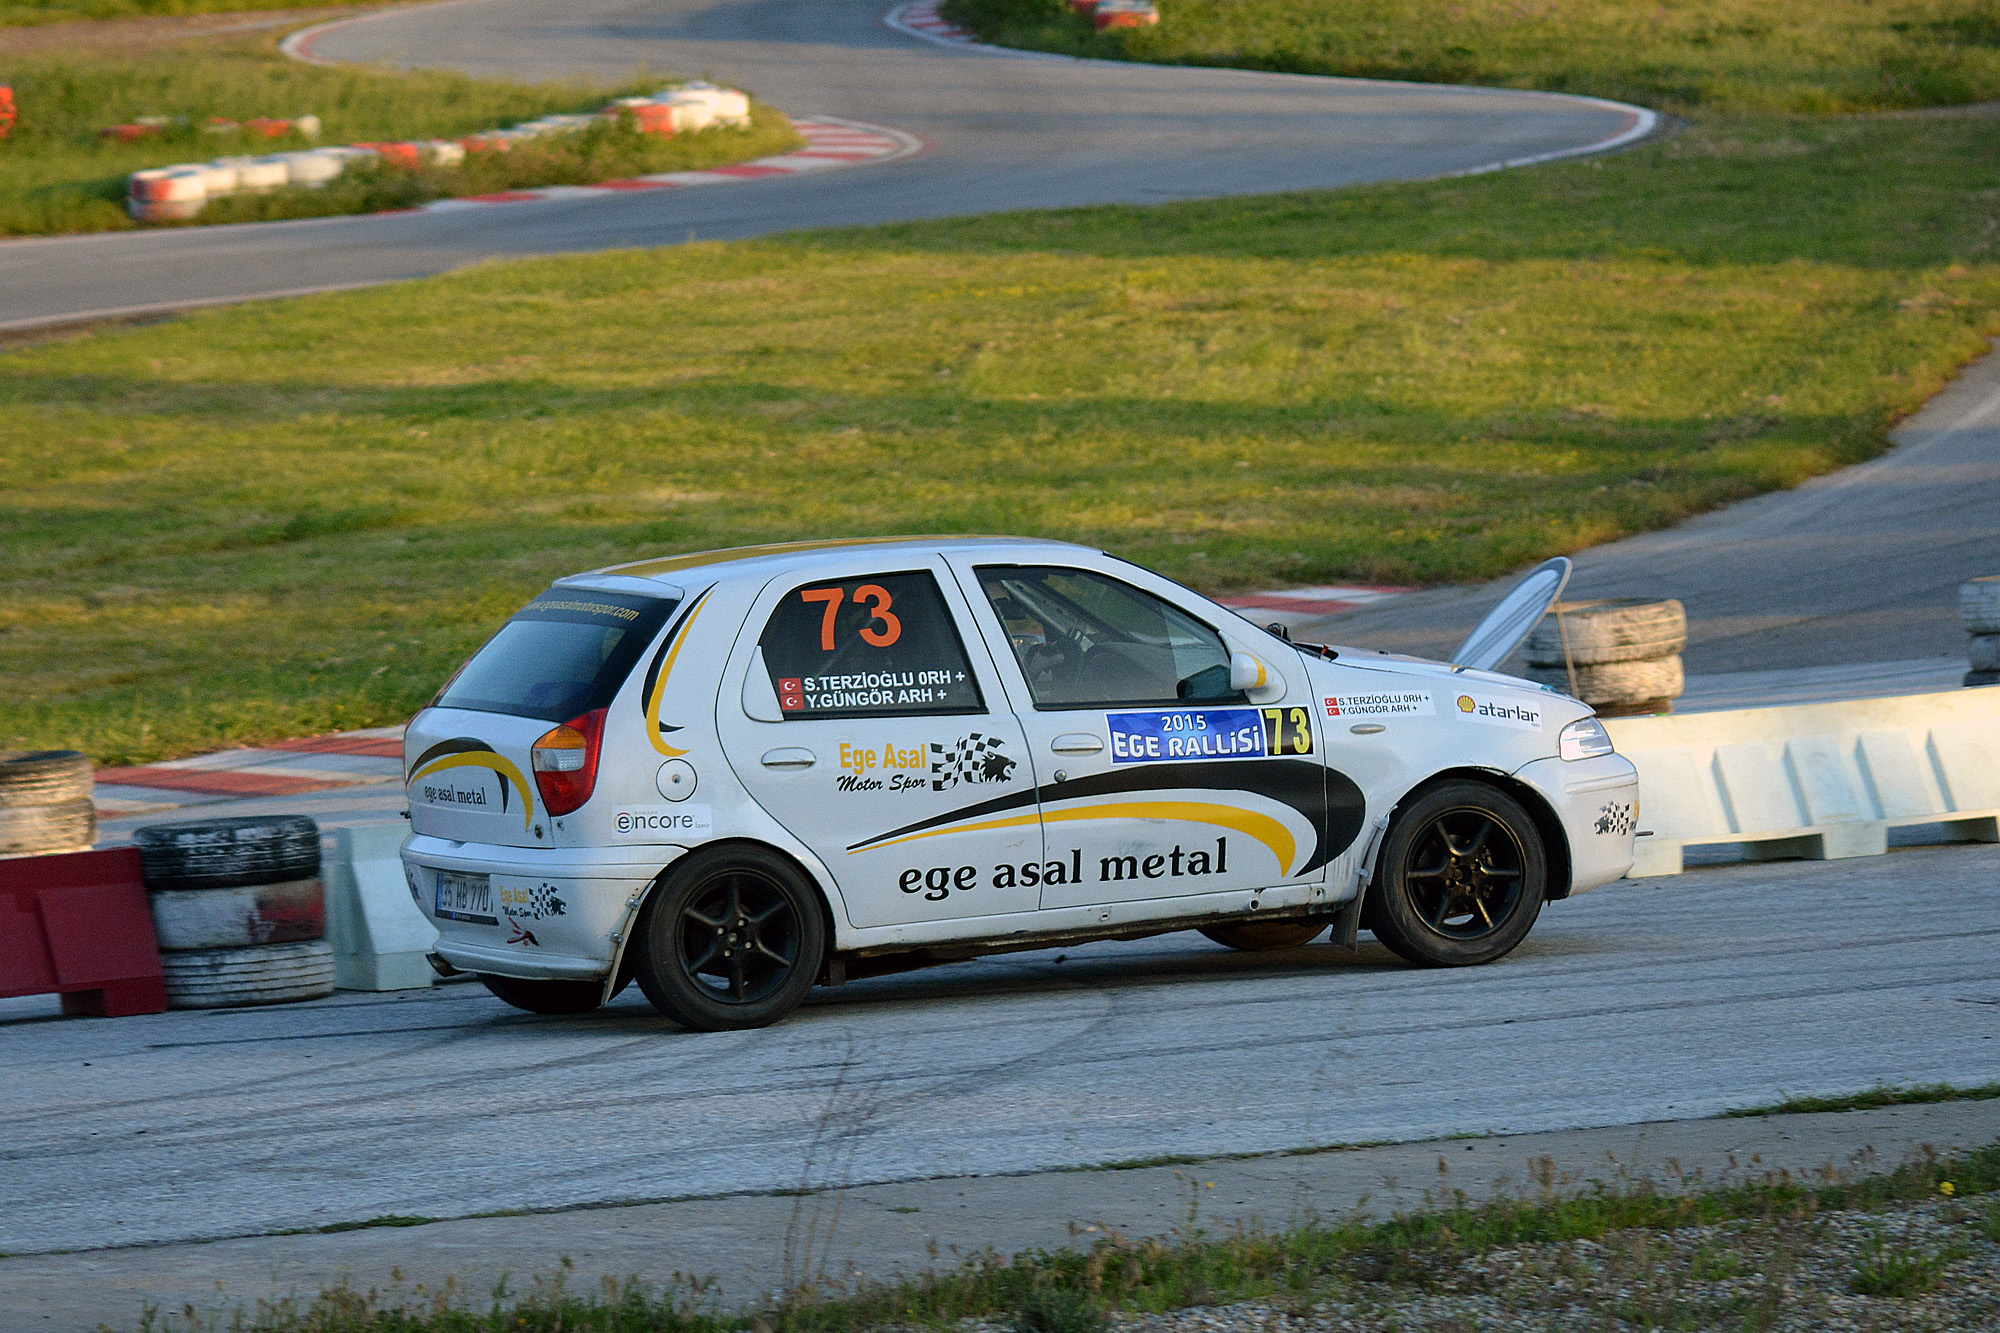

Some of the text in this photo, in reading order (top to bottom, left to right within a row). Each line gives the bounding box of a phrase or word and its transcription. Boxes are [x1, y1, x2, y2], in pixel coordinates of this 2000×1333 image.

[801, 584, 901, 650] 73
[805, 689, 894, 708] Y.GÜNGÖR
[897, 688, 933, 704] ARH
[1340, 705, 1388, 715] Y.GÜNGÖR
[1391, 704, 1410, 713] ARH
[1478, 702, 1539, 722] atarlar
[1161, 714, 1207, 732] 2015
[1265, 707, 1310, 755] 73
[1112, 731, 1161, 758] EGE
[839, 743, 927, 775] Ege Asal
[836, 774, 926, 794] Motor Spor
[424, 784, 487, 805] ege asal metal
[617, 814, 693, 830] encore
[899, 836, 1228, 902] ege asal metal
